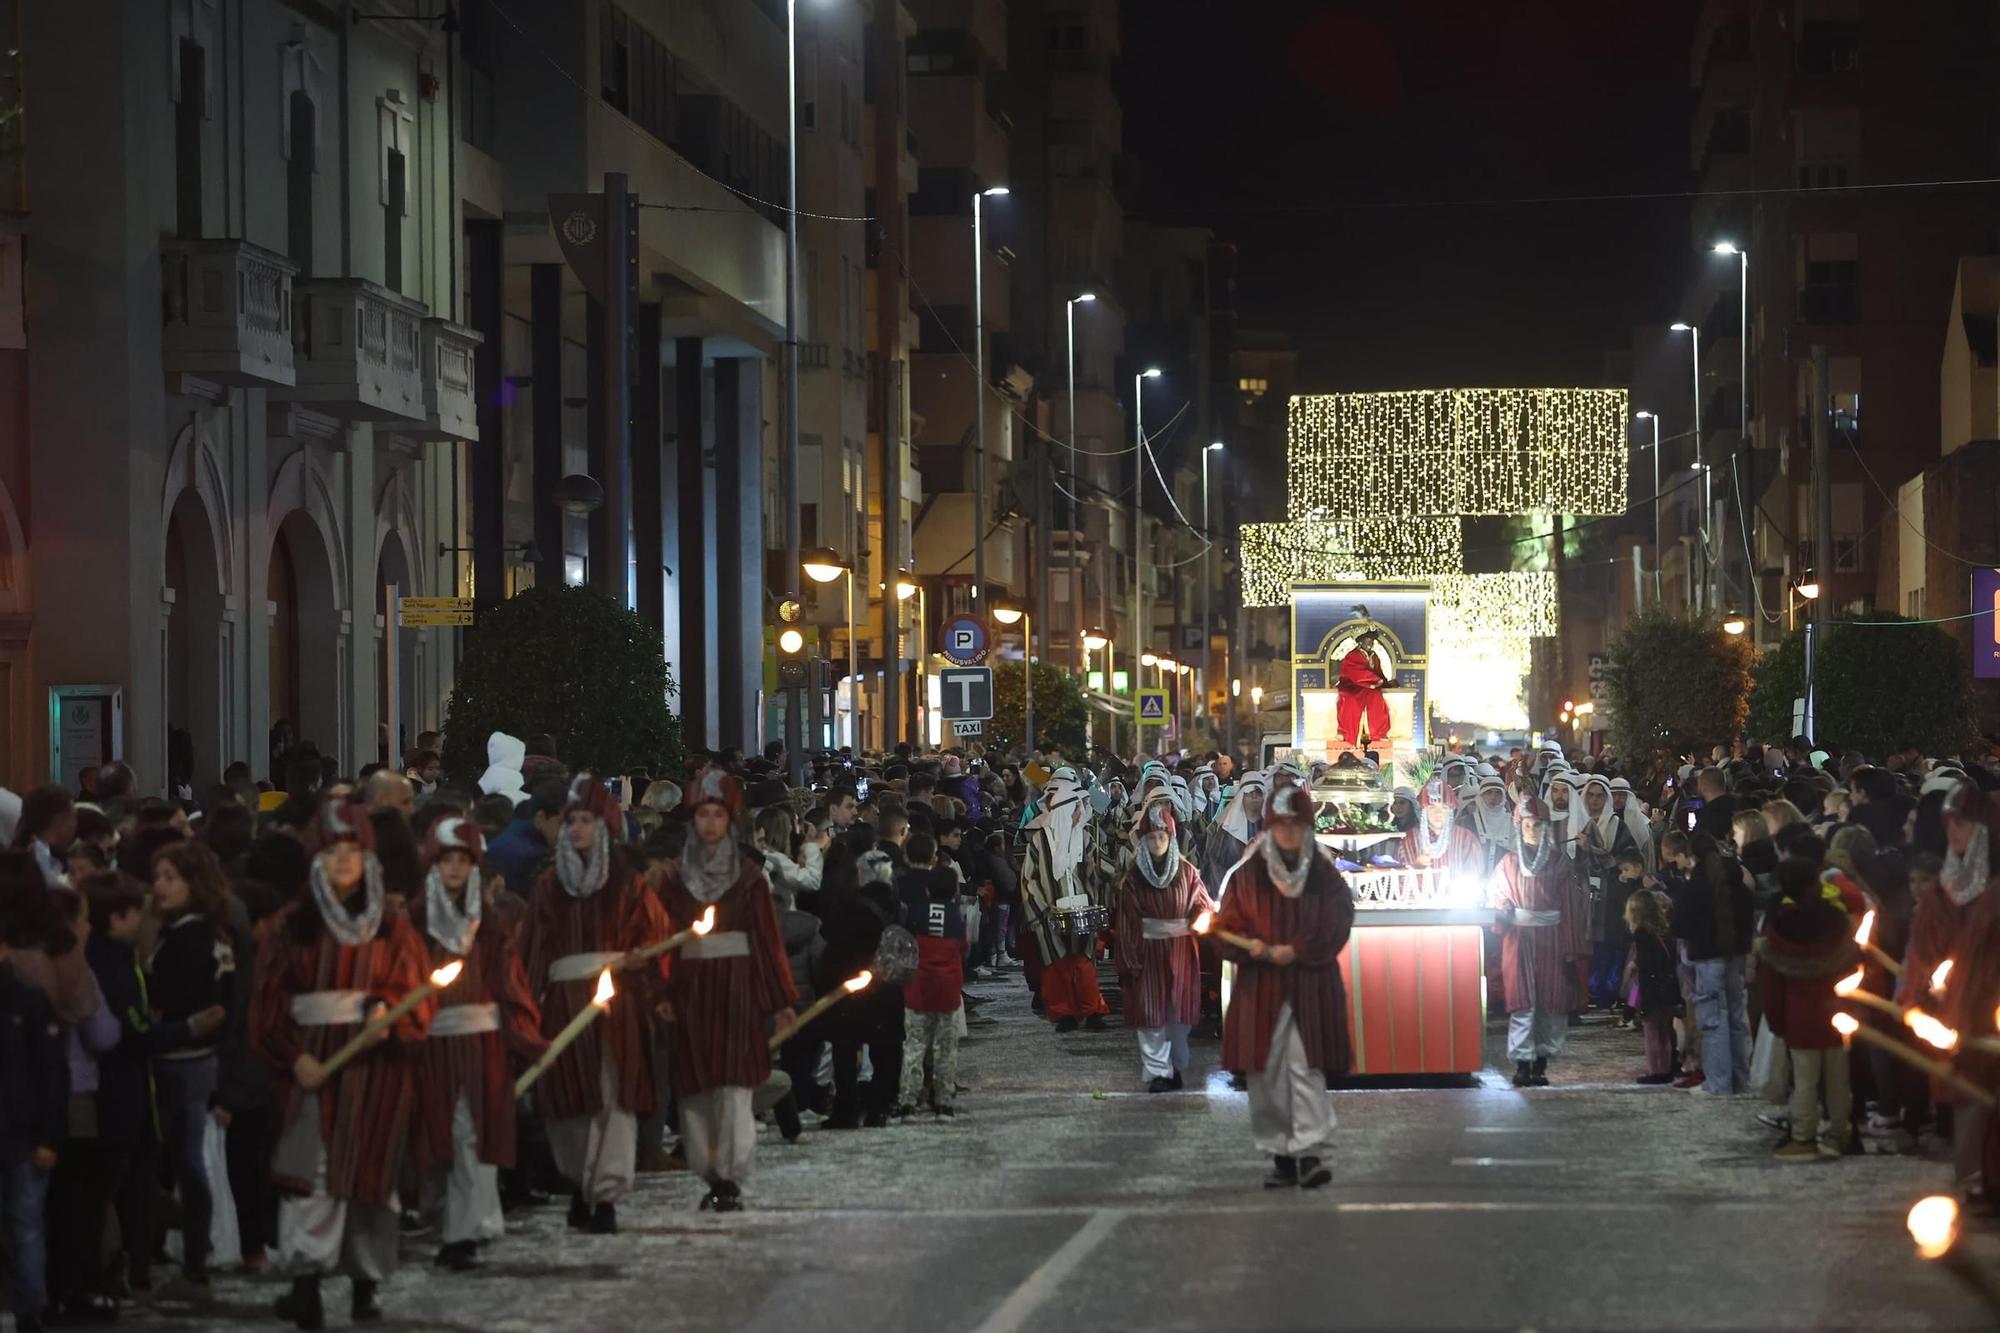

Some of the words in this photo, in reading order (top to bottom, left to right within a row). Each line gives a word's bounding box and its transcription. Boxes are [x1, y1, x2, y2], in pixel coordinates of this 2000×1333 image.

[957, 632, 972, 647] P
[947, 674, 984, 712] T
[954, 723, 980, 734] TAXI
[929, 903, 945, 926] LET
